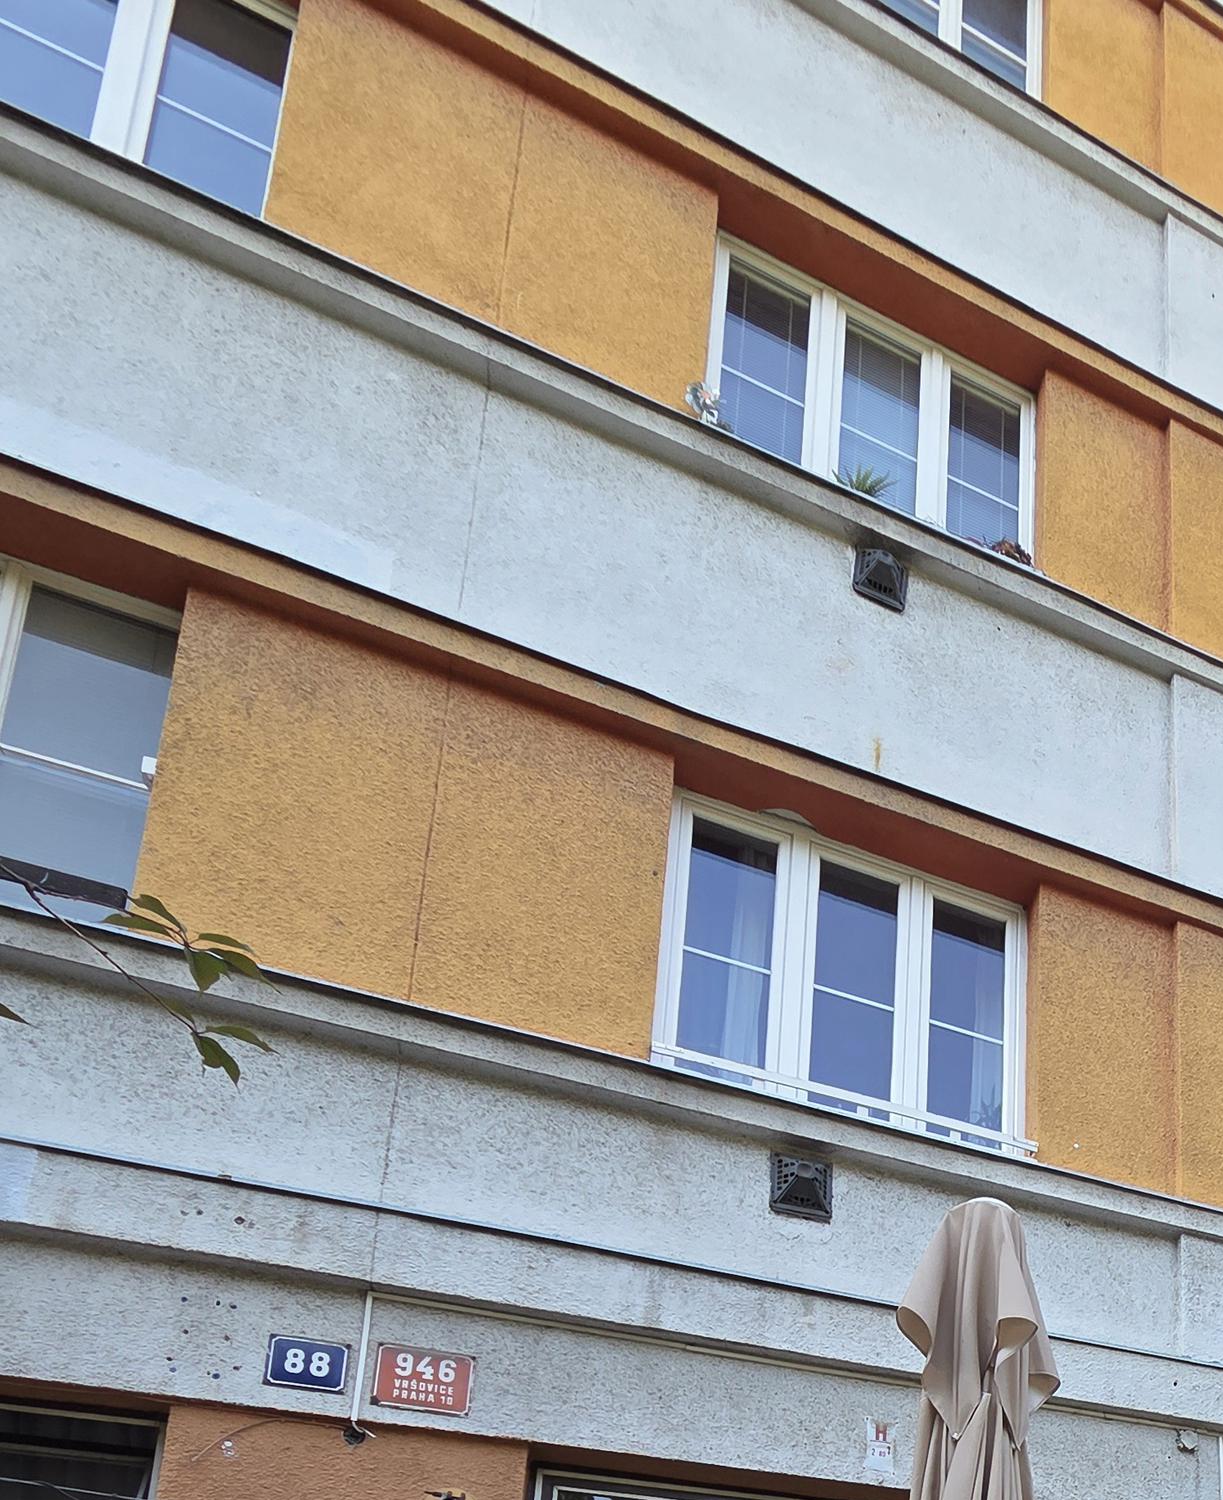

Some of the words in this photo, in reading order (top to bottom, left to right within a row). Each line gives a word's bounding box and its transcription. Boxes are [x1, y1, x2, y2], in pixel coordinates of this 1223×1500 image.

[284, 1348, 330, 1378] 88
[395, 1352, 457, 1383] 946
[393, 1388, 435, 1403] PRAHA
[440, 1396, 453, 1405] 10
[394, 1378, 454, 1396] VRŠOVICE
